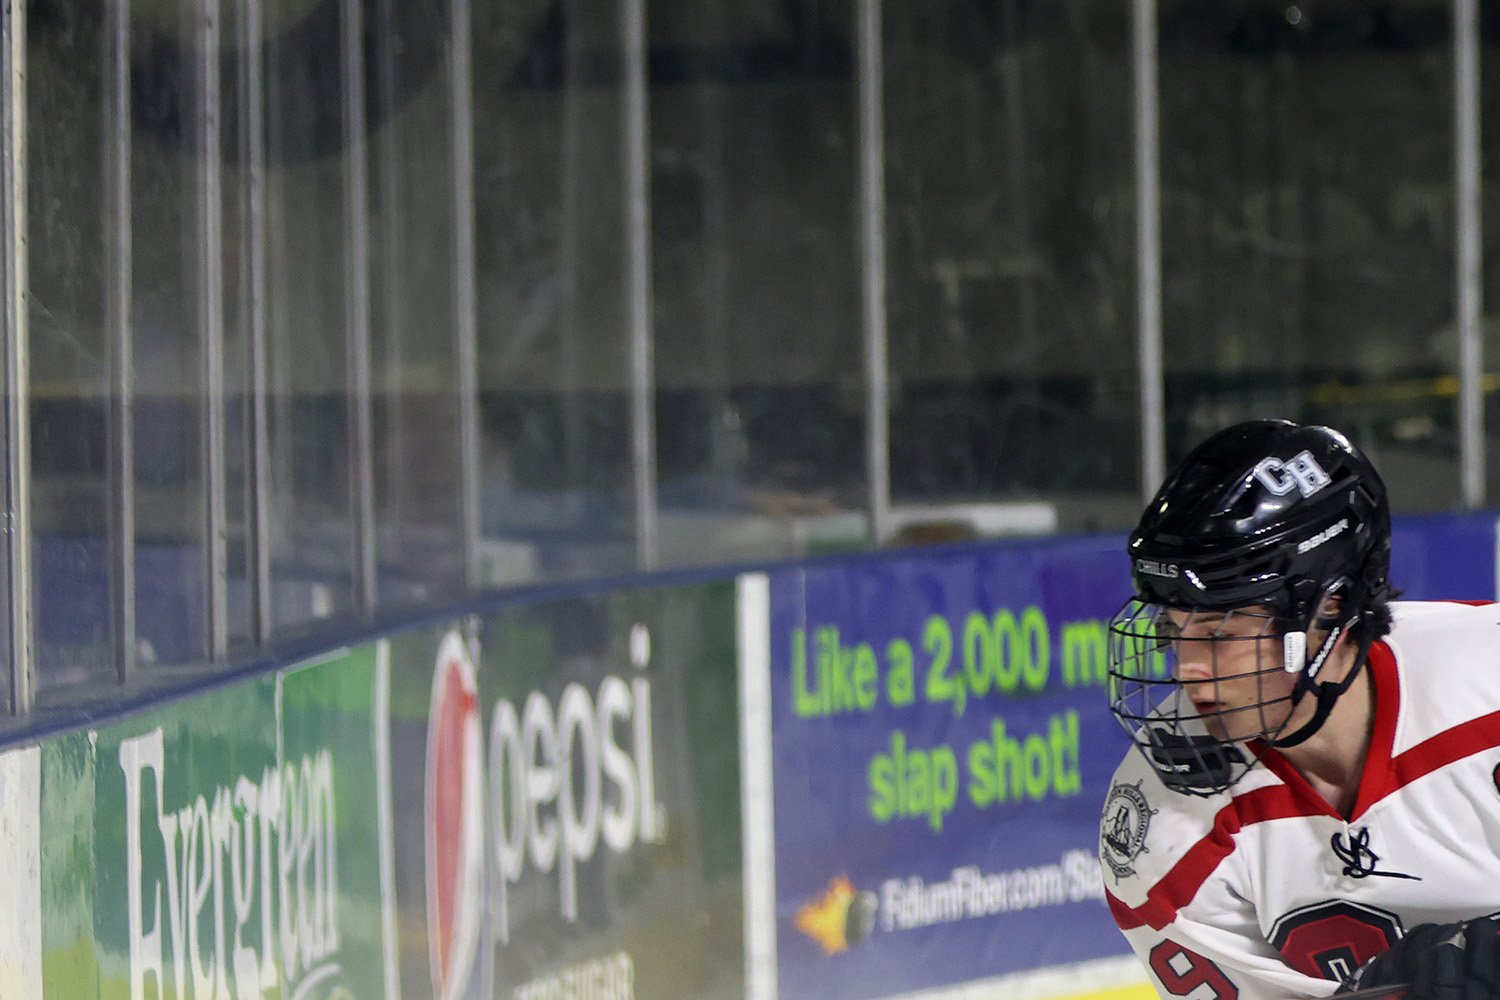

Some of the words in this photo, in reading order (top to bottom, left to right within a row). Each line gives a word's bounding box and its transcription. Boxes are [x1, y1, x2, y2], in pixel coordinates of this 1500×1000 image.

[1254, 450, 1331, 497] CH
[792, 625, 878, 718] Like
[887, 637, 915, 708] a
[923, 605, 1050, 716] 2,000
[491, 622, 653, 946] pepsi
[868, 732, 958, 834] slap
[967, 709, 1081, 808] shot!
